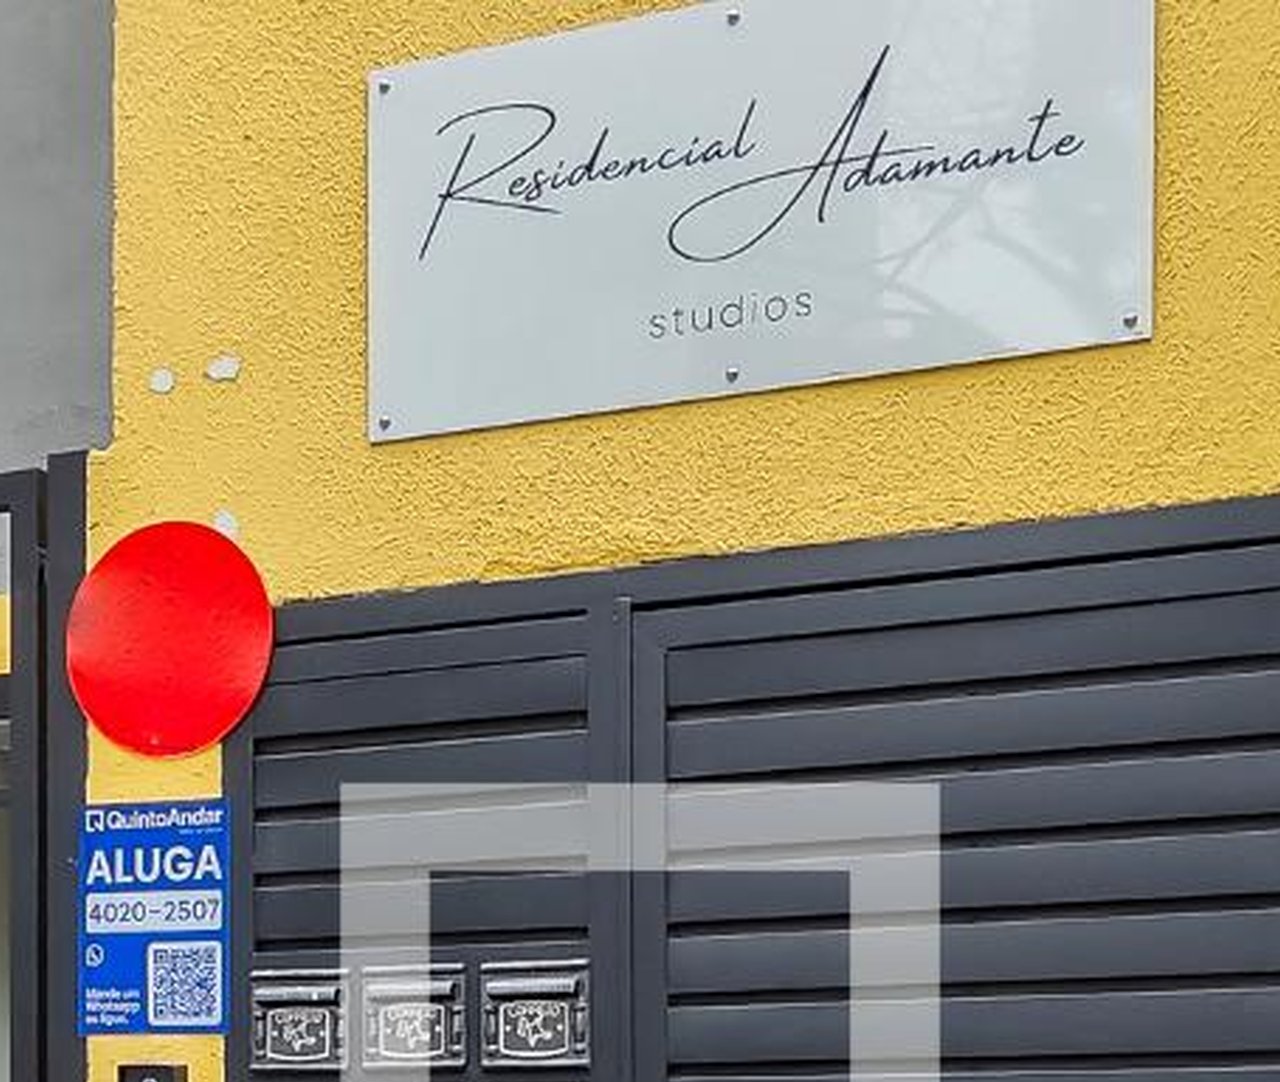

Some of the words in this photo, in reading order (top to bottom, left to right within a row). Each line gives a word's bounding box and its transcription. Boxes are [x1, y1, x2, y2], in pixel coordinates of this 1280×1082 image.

[419, 100, 757, 260] Residencial
[669, 44, 1086, 262] Adamante
[647, 289, 813, 341] studios
[107, 808, 223, 829] QuintoAndar
[86, 845, 222, 885] ALUGA
[88, 899, 220, 923] 4020-2507
